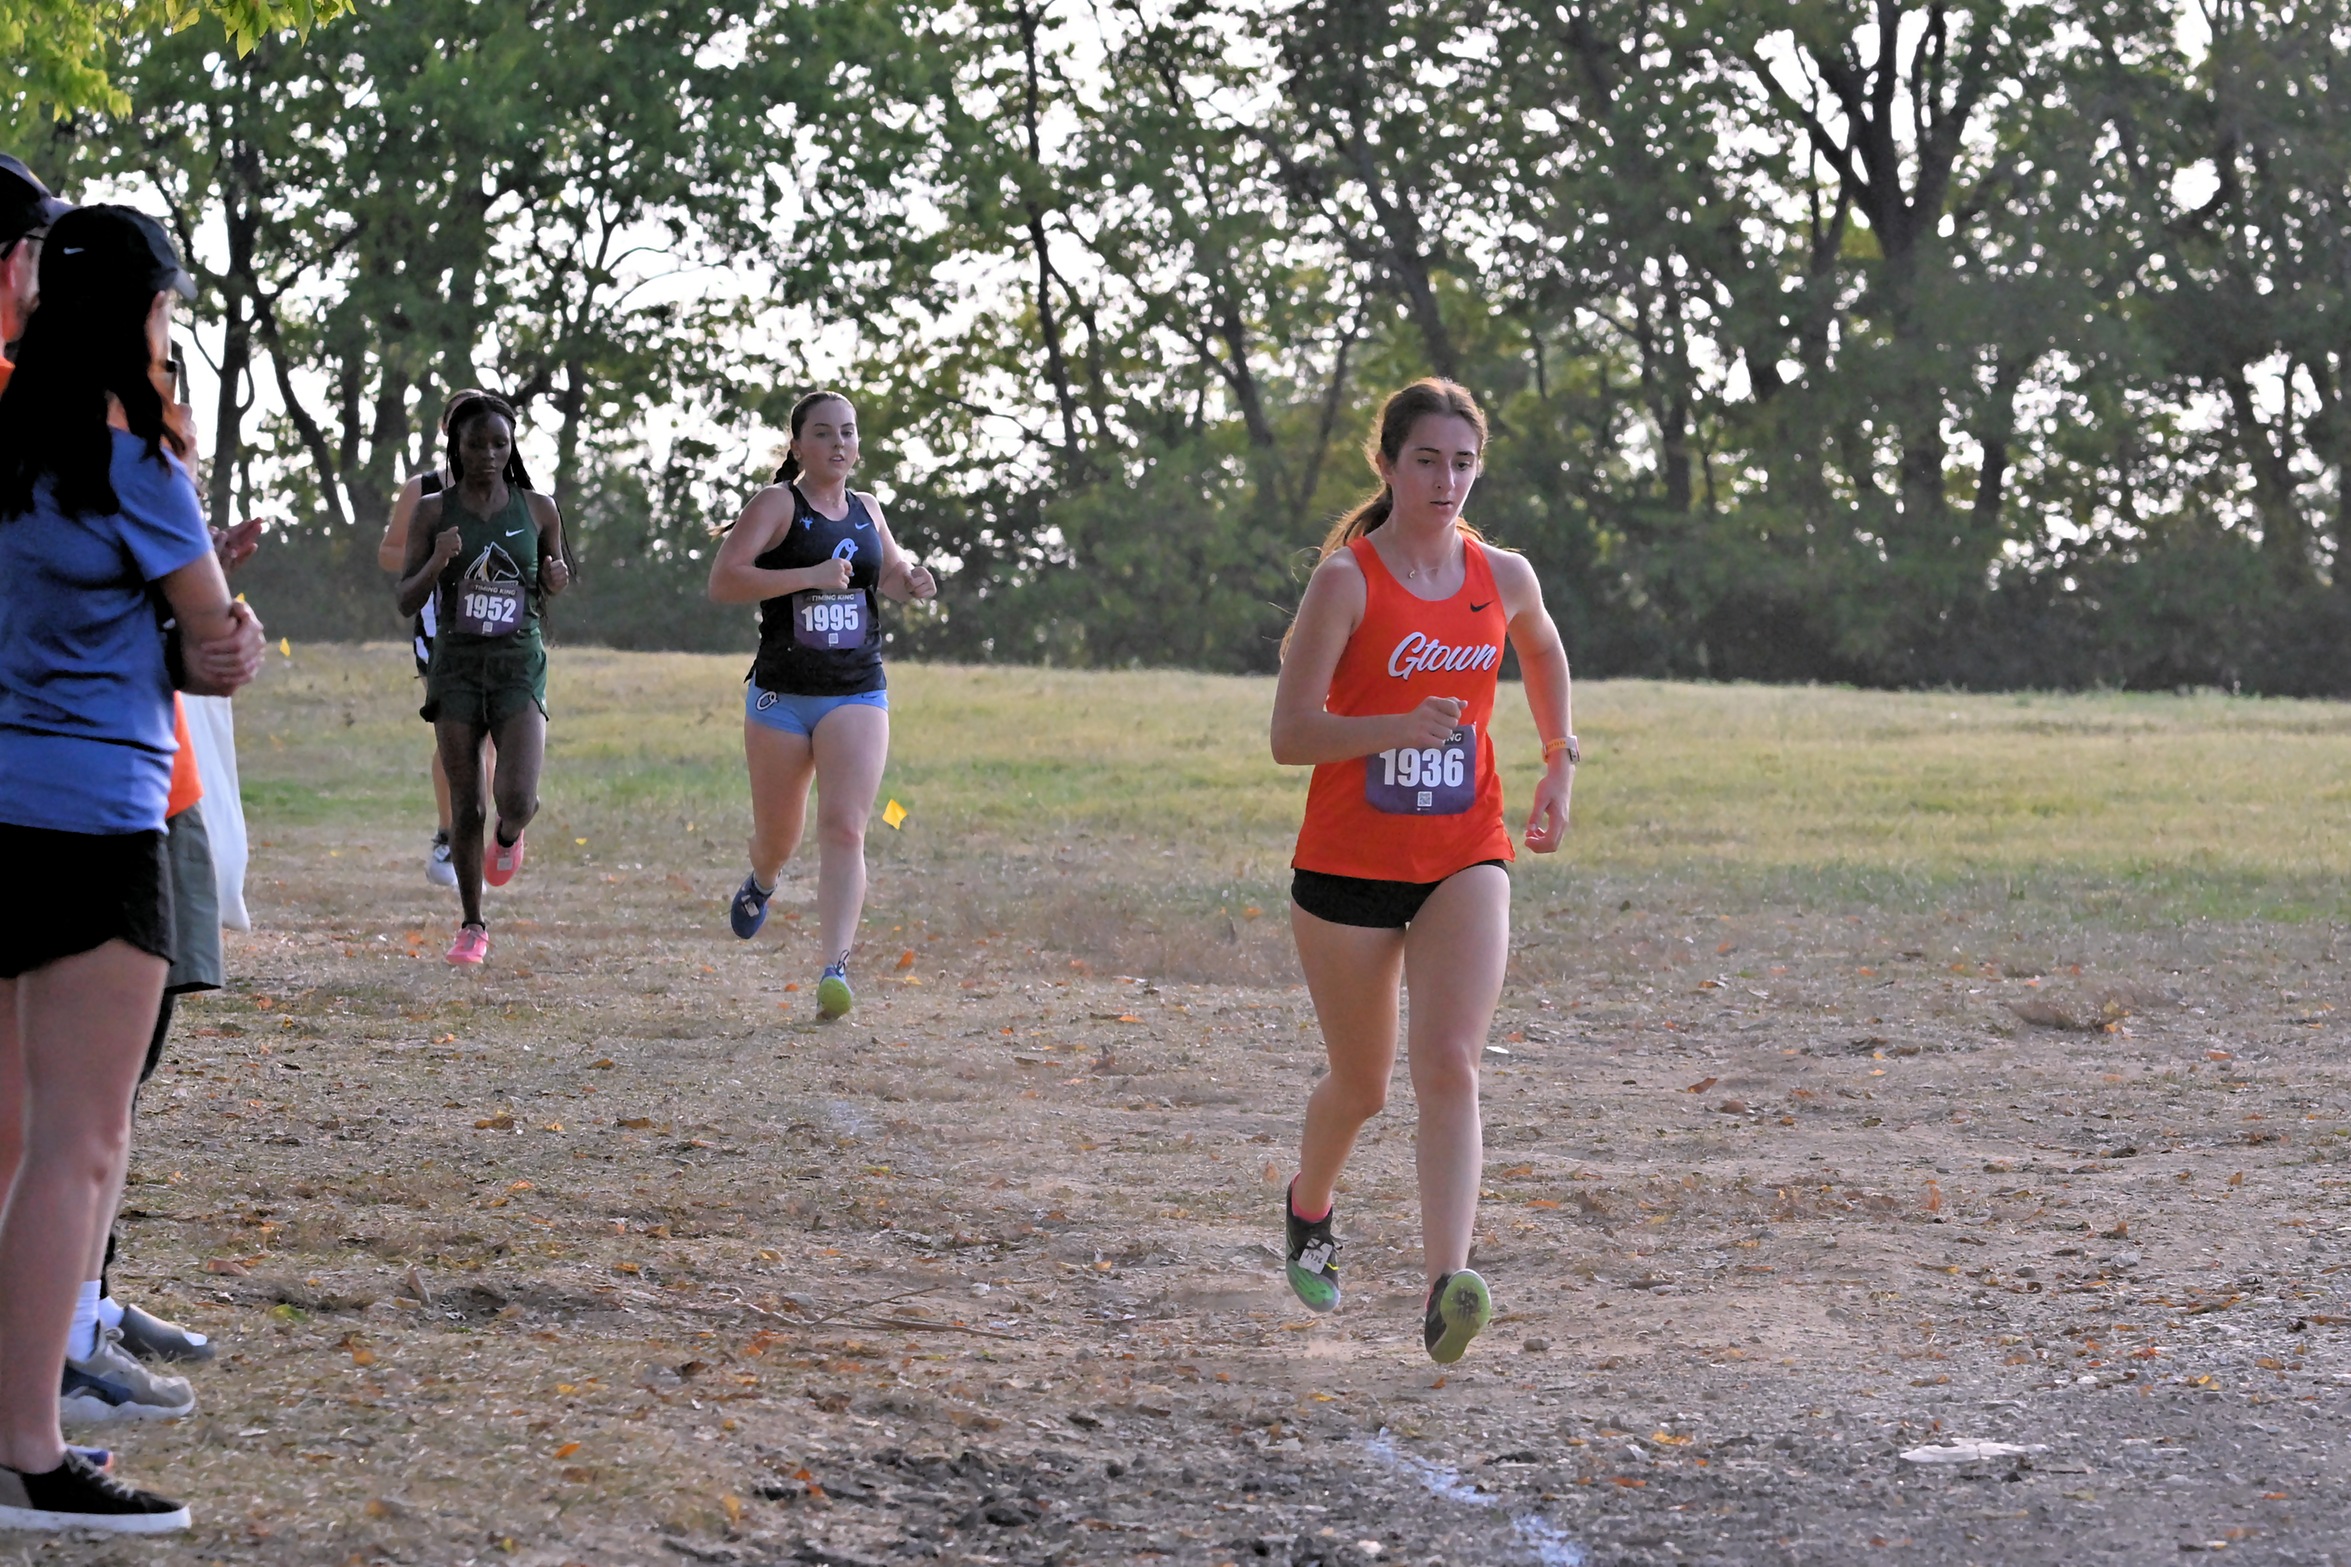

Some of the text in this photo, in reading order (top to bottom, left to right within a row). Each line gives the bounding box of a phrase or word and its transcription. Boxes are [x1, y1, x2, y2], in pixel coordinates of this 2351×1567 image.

[474, 584, 517, 596] TIMING KING
[837, 593, 855, 601] KING
[464, 593, 517, 623] 1952
[801, 603, 859, 632] 1995
[1388, 631, 1497, 681] Gtown
[1380, 748, 1464, 788] 1936
